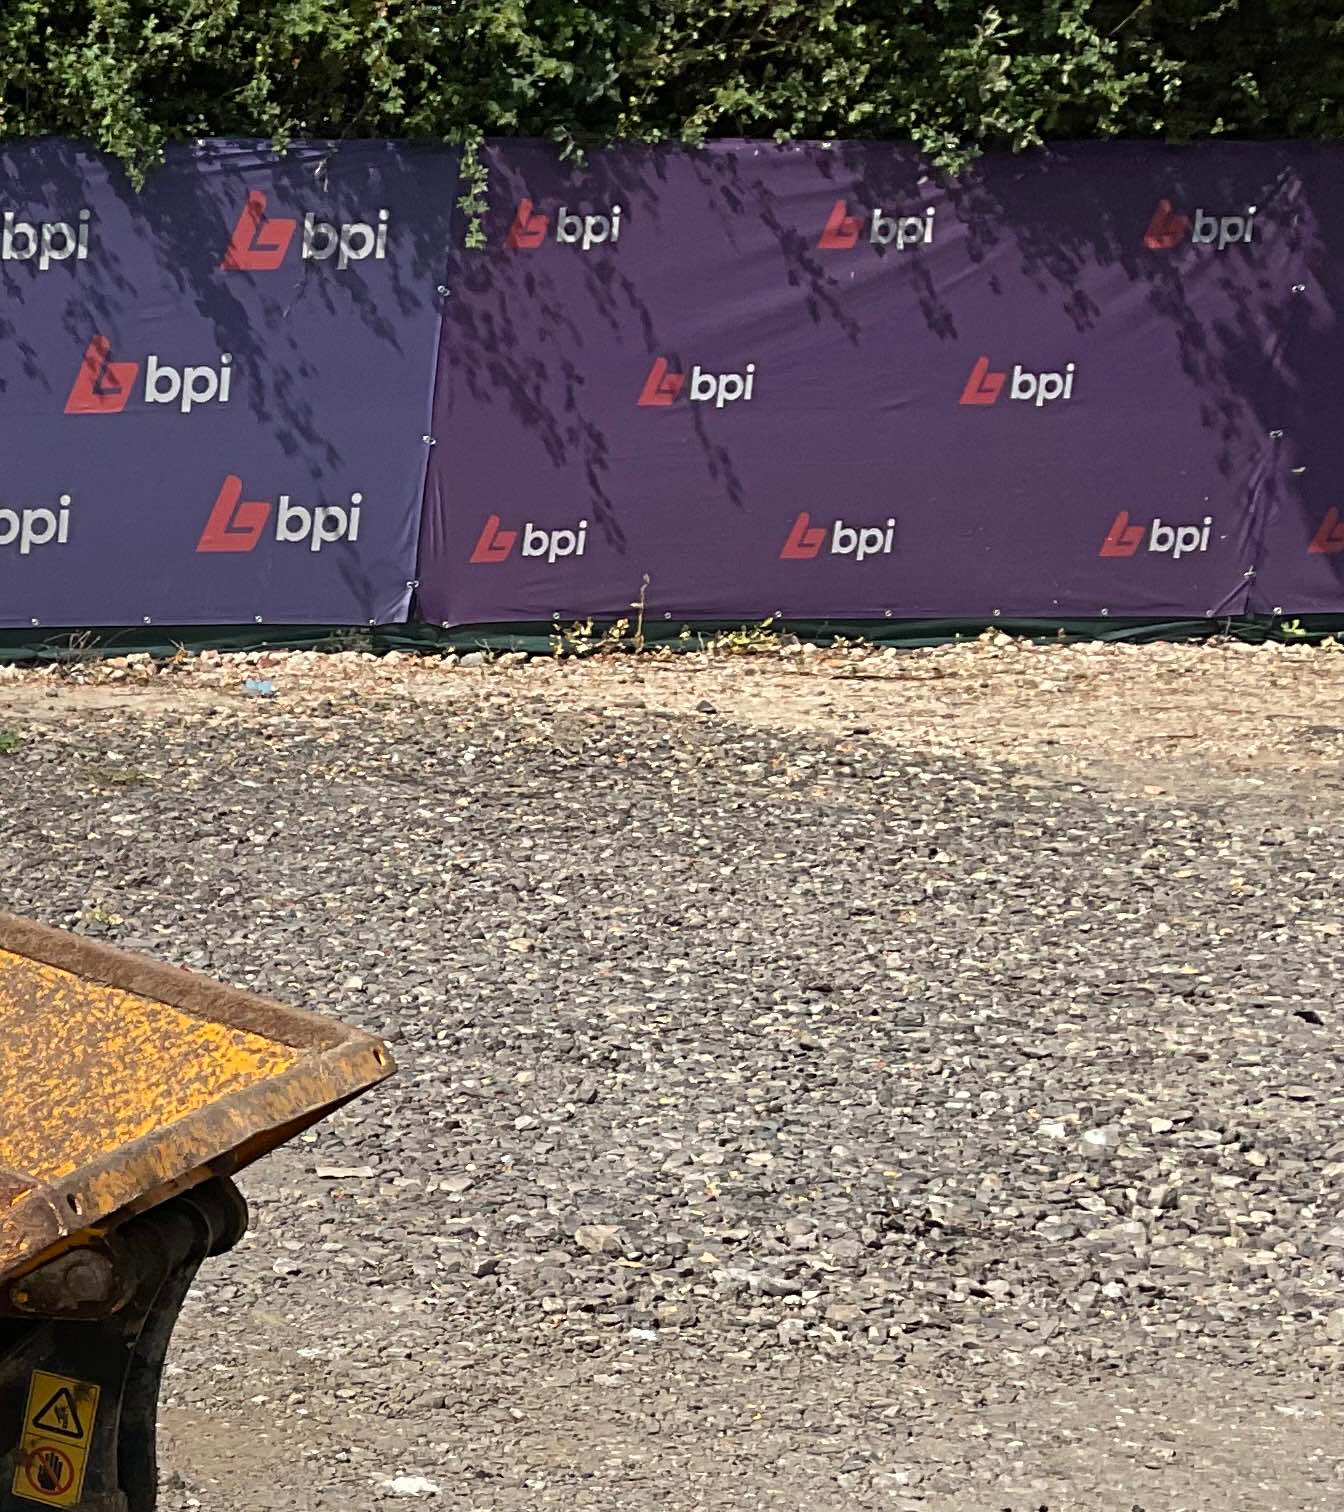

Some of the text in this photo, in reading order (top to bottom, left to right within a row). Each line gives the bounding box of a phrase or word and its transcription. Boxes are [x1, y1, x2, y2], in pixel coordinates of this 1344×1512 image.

[3, 211, 89, 270] bpi
[302, 210, 388, 269] bpi
[557, 206, 620, 250] bpi
[872, 207, 935, 249] bpi
[1192, 206, 1256, 249] bpi
[145, 354, 230, 412] bpi
[690, 364, 755, 407] bpi
[1010, 363, 1074, 406] bpi
[276, 493, 362, 551] bpi
[522, 521, 587, 562] bpi
[832, 519, 895, 560] bpi
[1149, 517, 1211, 558] bpi
